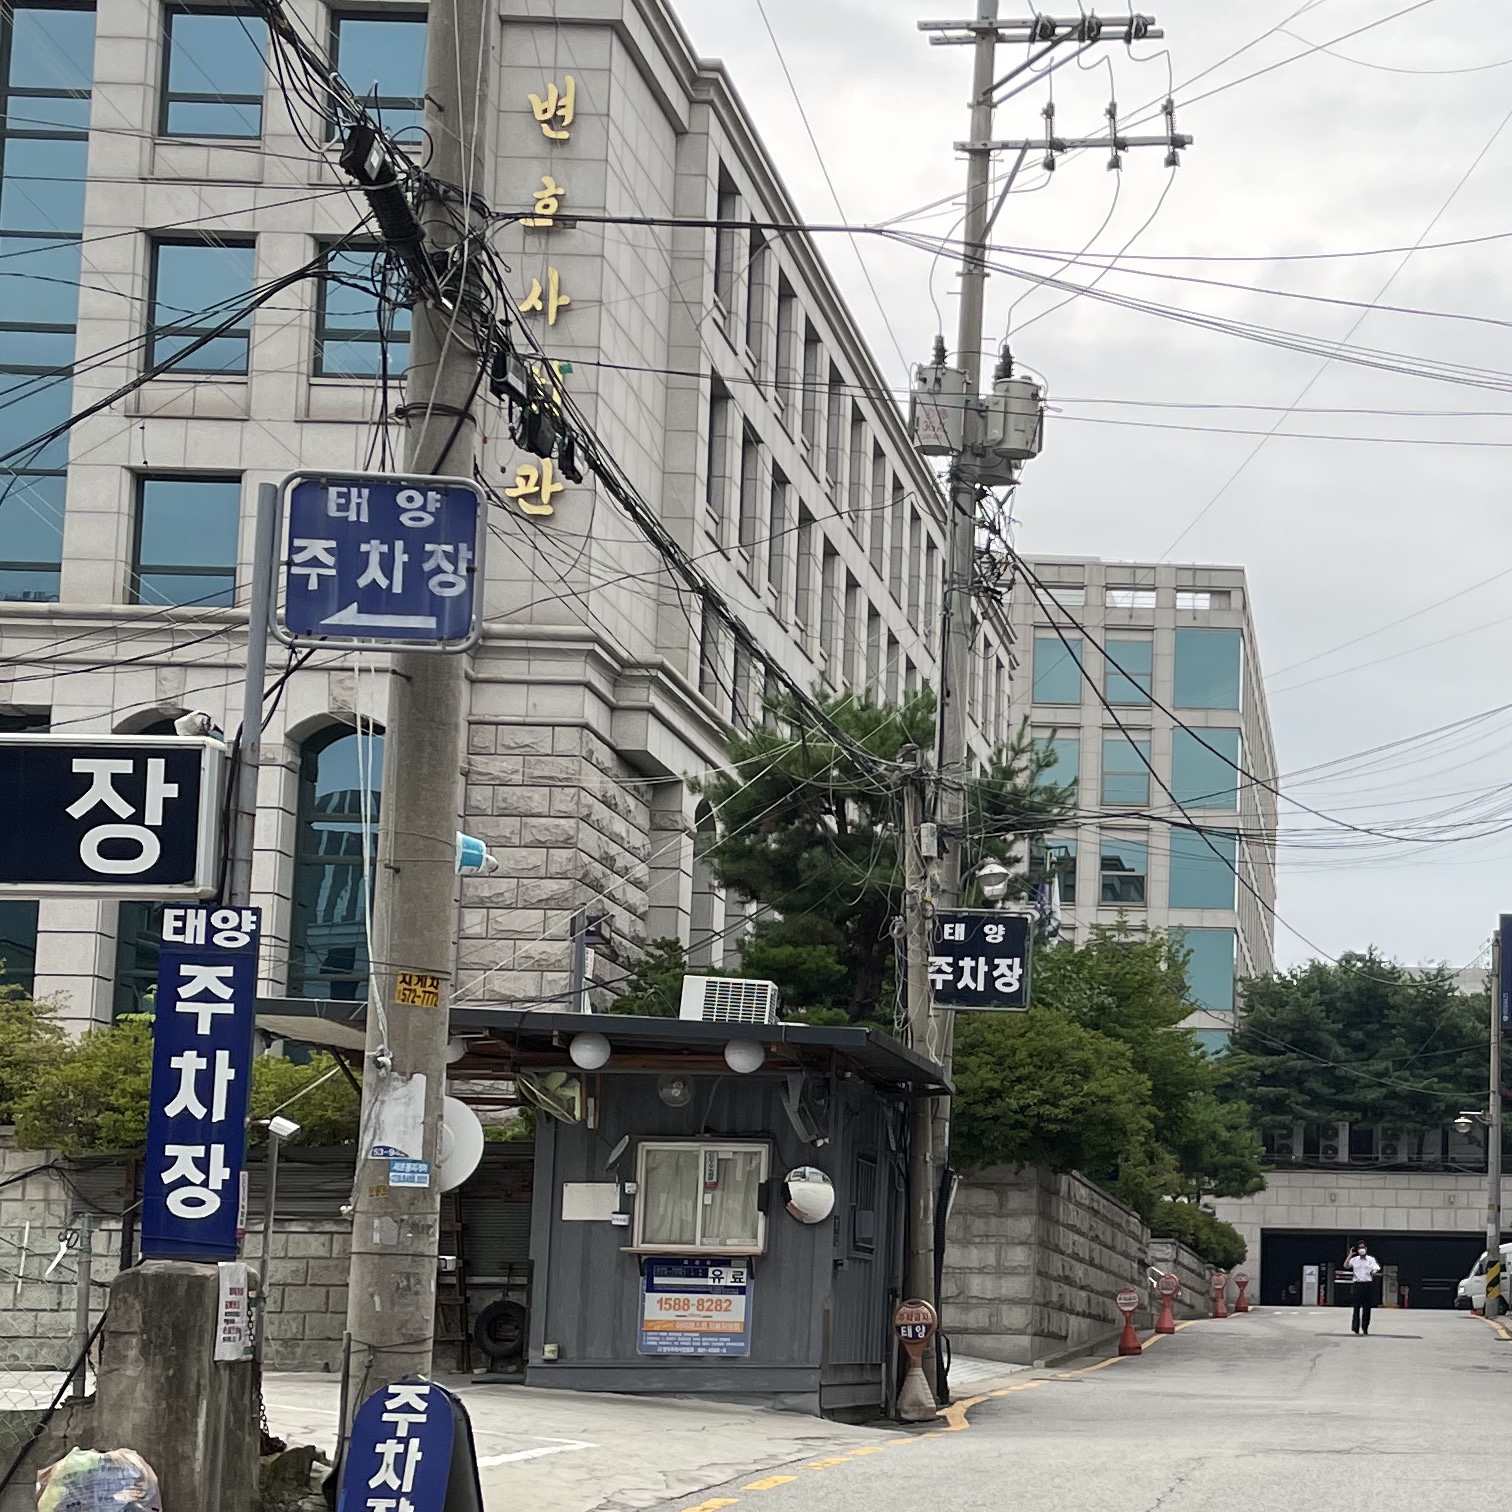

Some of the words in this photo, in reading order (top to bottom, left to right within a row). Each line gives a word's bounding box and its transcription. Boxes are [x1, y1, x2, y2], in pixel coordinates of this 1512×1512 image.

[289, 536, 475, 599] 주차장
[64, 757, 180, 875] 장
[162, 908, 258, 949] 태양
[927, 956, 1023, 994] 주차장
[160, 964, 237, 1221] 주차장
[708, 1267, 746, 1285] 유료
[656, 1296, 733, 1313] 1588-8282
[900, 1324, 926, 1339] 태양
